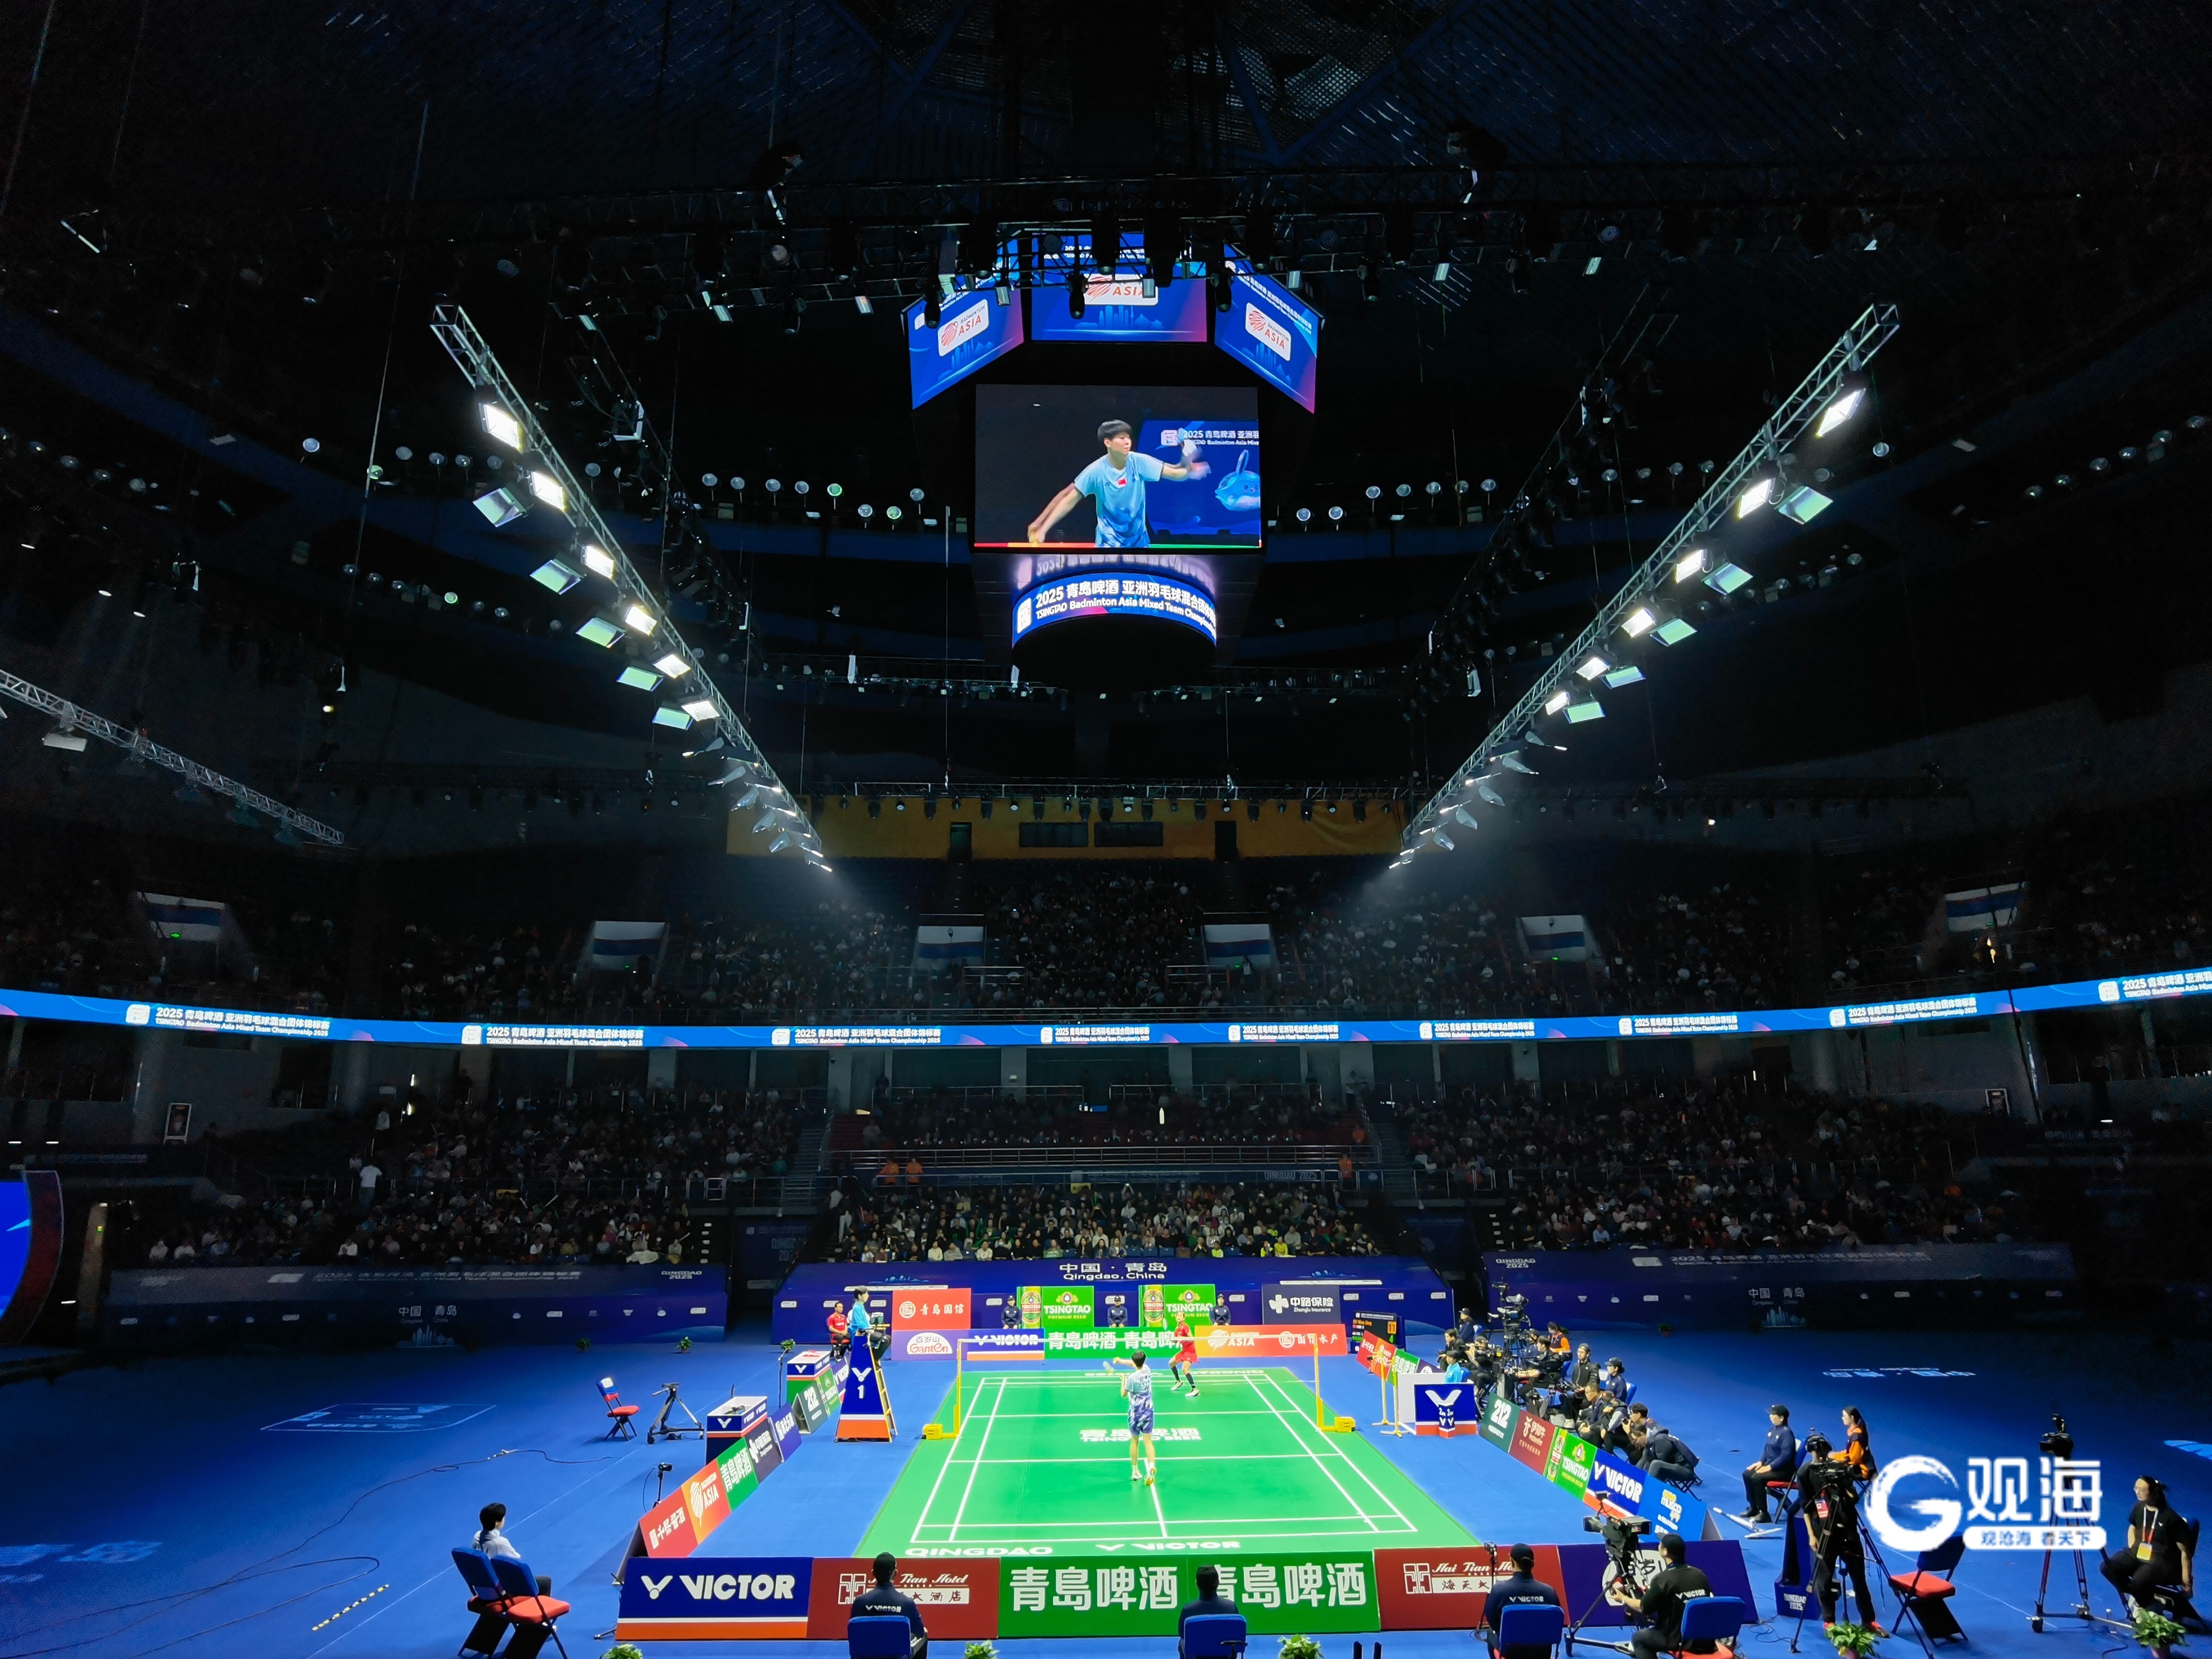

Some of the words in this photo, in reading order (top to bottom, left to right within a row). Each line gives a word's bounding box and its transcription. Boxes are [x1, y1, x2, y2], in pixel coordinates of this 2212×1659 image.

[959, 315, 981, 336] ASIA
[1264, 328, 1285, 349] ASIA
[1036, 586, 1064, 608] 2025
[1036, 603, 1068, 620] TSINGTAO
[1069, 597, 1117, 610] Badminton
[1118, 597, 1137, 606] Asia
[1139, 598, 1164, 610] Mixed
[1165, 601, 1184, 615] Team
[2123, 977, 2147, 990] 2025
[2152, 986, 2185, 995] Badminton
[156, 1007, 184, 1018] 2025
[1849, 1007, 1866, 1017] 2025
[487, 1027, 510, 1036] 2025
[795, 1029, 816, 1037] 2025
[1060, 1263, 1100, 1273] 中国
[1125, 1262, 1166, 1272] 青岛
[1748, 1288, 1770, 1299] 中国
[1783, 1287, 1805, 1298] 青岛
[1165, 1303, 1213, 1312] TSINGTAO
[1290, 1297, 1333, 1307] 中路保险
[399, 1305, 421, 1317] 中国
[434, 1304, 457, 1317] 青岛
[920, 1303, 965, 1316] 青岛国信
[1043, 1305, 1091, 1314] TSINGTAO
[1389, 1323, 1395, 1332] 11
[990, 1334, 1038, 1346] VICTOR
[1228, 1337, 1255, 1346] ASIA
[1389, 1334, 1393, 1344] 4
[857, 1385, 864, 1399] 1
[804, 1386, 819, 1412] 212
[1491, 1399, 1512, 1429] 212
[1562, 1456, 1589, 1481] TSINGTAO
[1606, 1466, 1643, 1503] VICTOR
[703, 1483, 719, 1509] ASIA
[1131, 1541, 1242, 1550] VICTOR
[905, 1547, 1054, 1557] QINGDAO
[1432, 1563, 1458, 1573] Hai
[1462, 1562, 1491, 1572] Tian
[900, 1573, 928, 1583] Tian
[932, 1573, 969, 1583] Hotel
[680, 1574, 795, 1600] VICTOR
[1682, 1589, 1706, 1599] VICTOR
[1789, 1601, 1803, 1611] 2025
